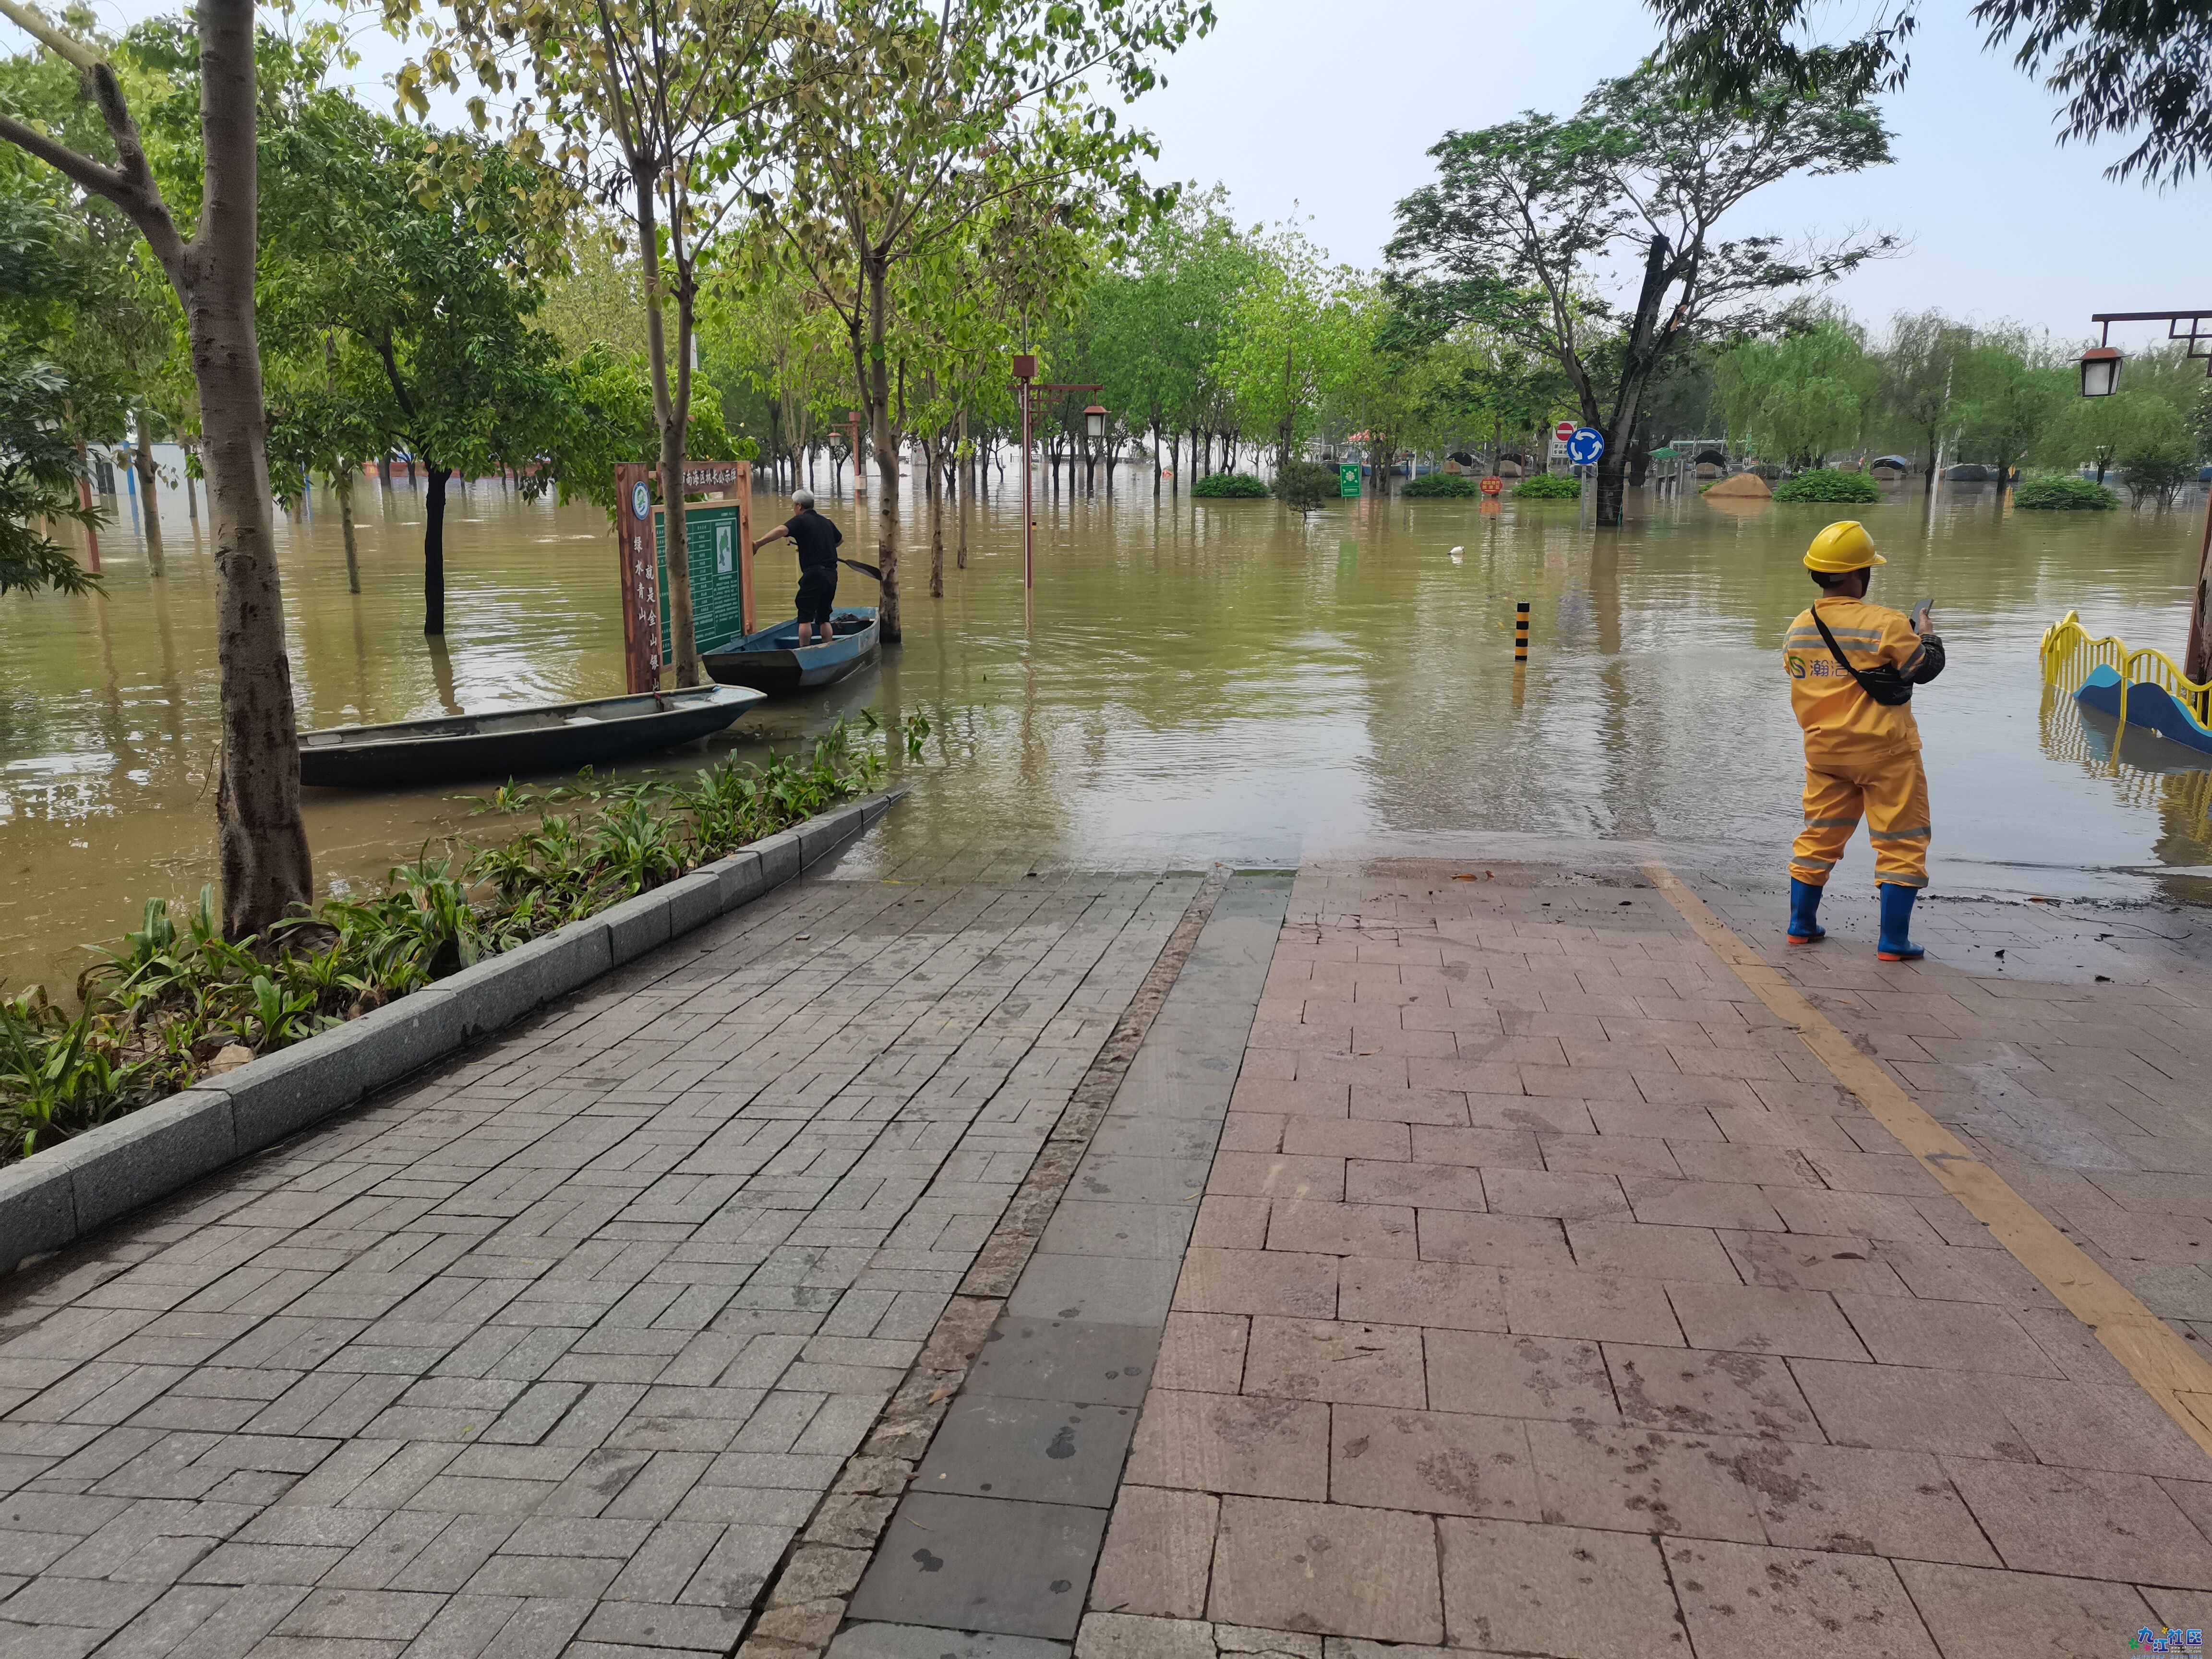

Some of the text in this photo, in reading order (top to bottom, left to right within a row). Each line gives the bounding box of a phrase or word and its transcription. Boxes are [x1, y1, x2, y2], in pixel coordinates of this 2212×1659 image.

[634, 536, 646, 621] 绿水青山
[645, 565, 659, 691] 就是金山银山
